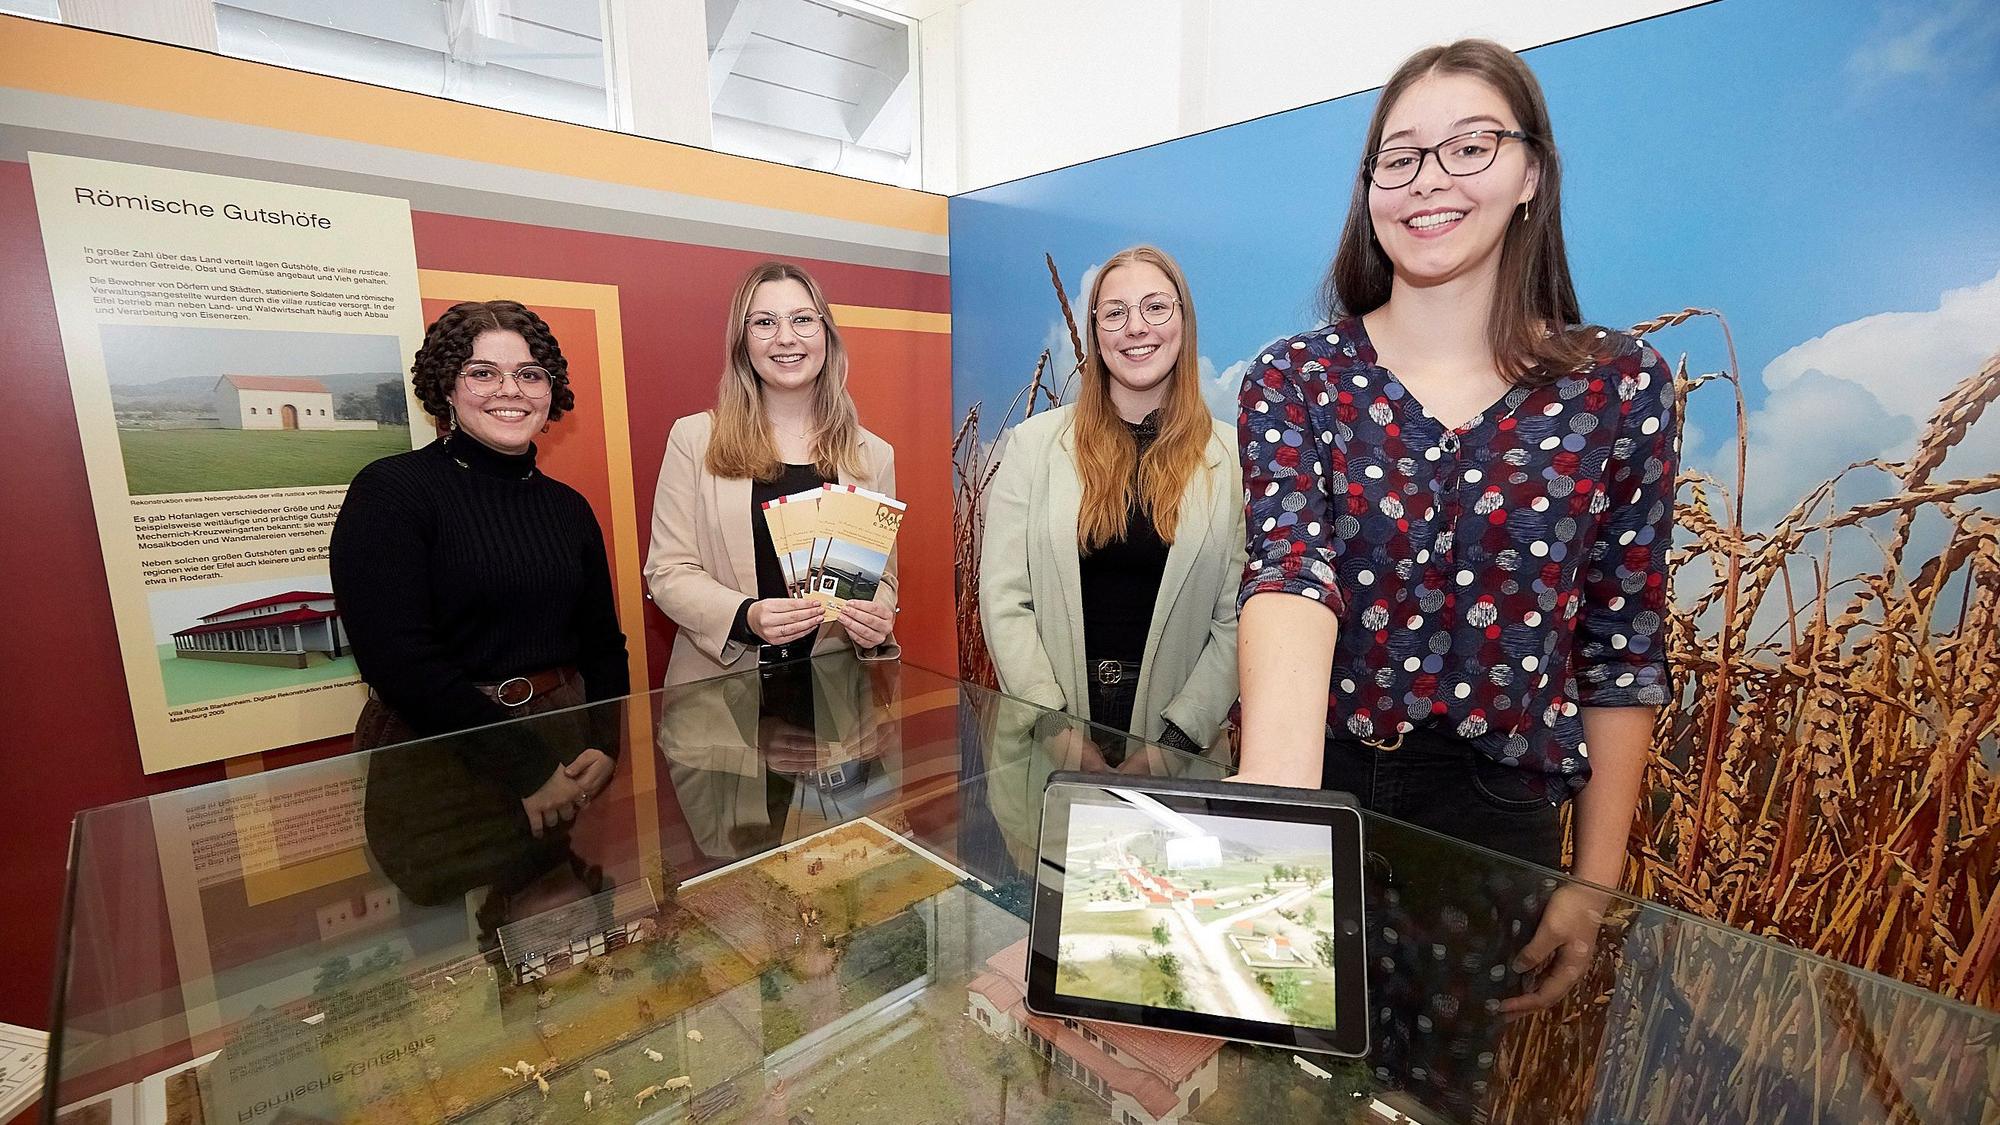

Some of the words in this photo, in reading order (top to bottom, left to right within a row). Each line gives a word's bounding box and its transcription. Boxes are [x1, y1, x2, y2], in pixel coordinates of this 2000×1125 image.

[75, 188, 214, 217] Römische
[224, 203, 330, 229] Gutshöfe
[86, 257, 107, 265] Dort
[110, 260, 147, 268] wurden
[150, 261, 192, 272] Getreide,
[195, 265, 217, 273] Obst
[239, 268, 274, 277] Gemüse
[277, 272, 315, 280] angebaut
[353, 277, 388, 285] gehalten.
[96, 249, 129, 257] großer
[133, 251, 153, 259] Zahl
[156, 253, 177, 261] über
[181, 254, 197, 262] das
[200, 256, 221, 264] Land
[224, 259, 253, 267] verteilt
[256, 260, 279, 269] lagen
[282, 262, 320, 273] Gutshöfe,
[337, 267, 356, 275] villae
[359, 269, 390, 277] rusticae.
[90, 277, 106, 285] Die
[108, 279, 155, 288] Bewohner
[229, 286, 264, 296] Städten,
[265, 288, 308, 297] stationierte
[310, 291, 343, 299] Soldaten
[91, 287, 201, 300] Verwaltungsangestellte
[204, 294, 237, 302] wurden
[240, 295, 264, 303] durch
[281, 298, 302, 306] villae
[338, 303, 371, 311] versorgt.
[93, 297, 115, 305] Eifel
[118, 299, 151, 307] betrieb
[209, 303, 233, 311] Land-
[255, 305, 315, 315] Waldwirtschaft
[318, 308, 341, 317] häufig
[117, 308, 178, 319] Verarbeitung
[200, 312, 251, 320] Eisenerzen.
[135, 521, 201, 532] beispielsweise
[204, 518, 250, 527] weitläufige
[271, 514, 308, 524] prächtige
[148, 514, 165, 523] gab
[169, 512, 219, 520] Hofanlagen
[222, 508, 280, 517] verschiedener
[283, 505, 308, 513] Größe
[137, 525, 263, 540] Mechernich-Kreuzweingarten
[267, 521, 302, 530] bekannt:
[221, 532, 286, 543] Wandmalereien
[288, 529, 327, 538] versehen.
[142, 559, 171, 567] Neben
[175, 556, 210, 565] solchen
[212, 553, 242, 563] großen
[245, 549, 286, 558] Gutshöfen
[289, 546, 304, 556] gab
[144, 568, 181, 577] regionen
[217, 561, 234, 569] Eifel
[237, 559, 255, 567] auch
[258, 557, 289, 565] kleinere
[291, 553, 305, 561] und
[180, 571, 223, 582] Roderath.
